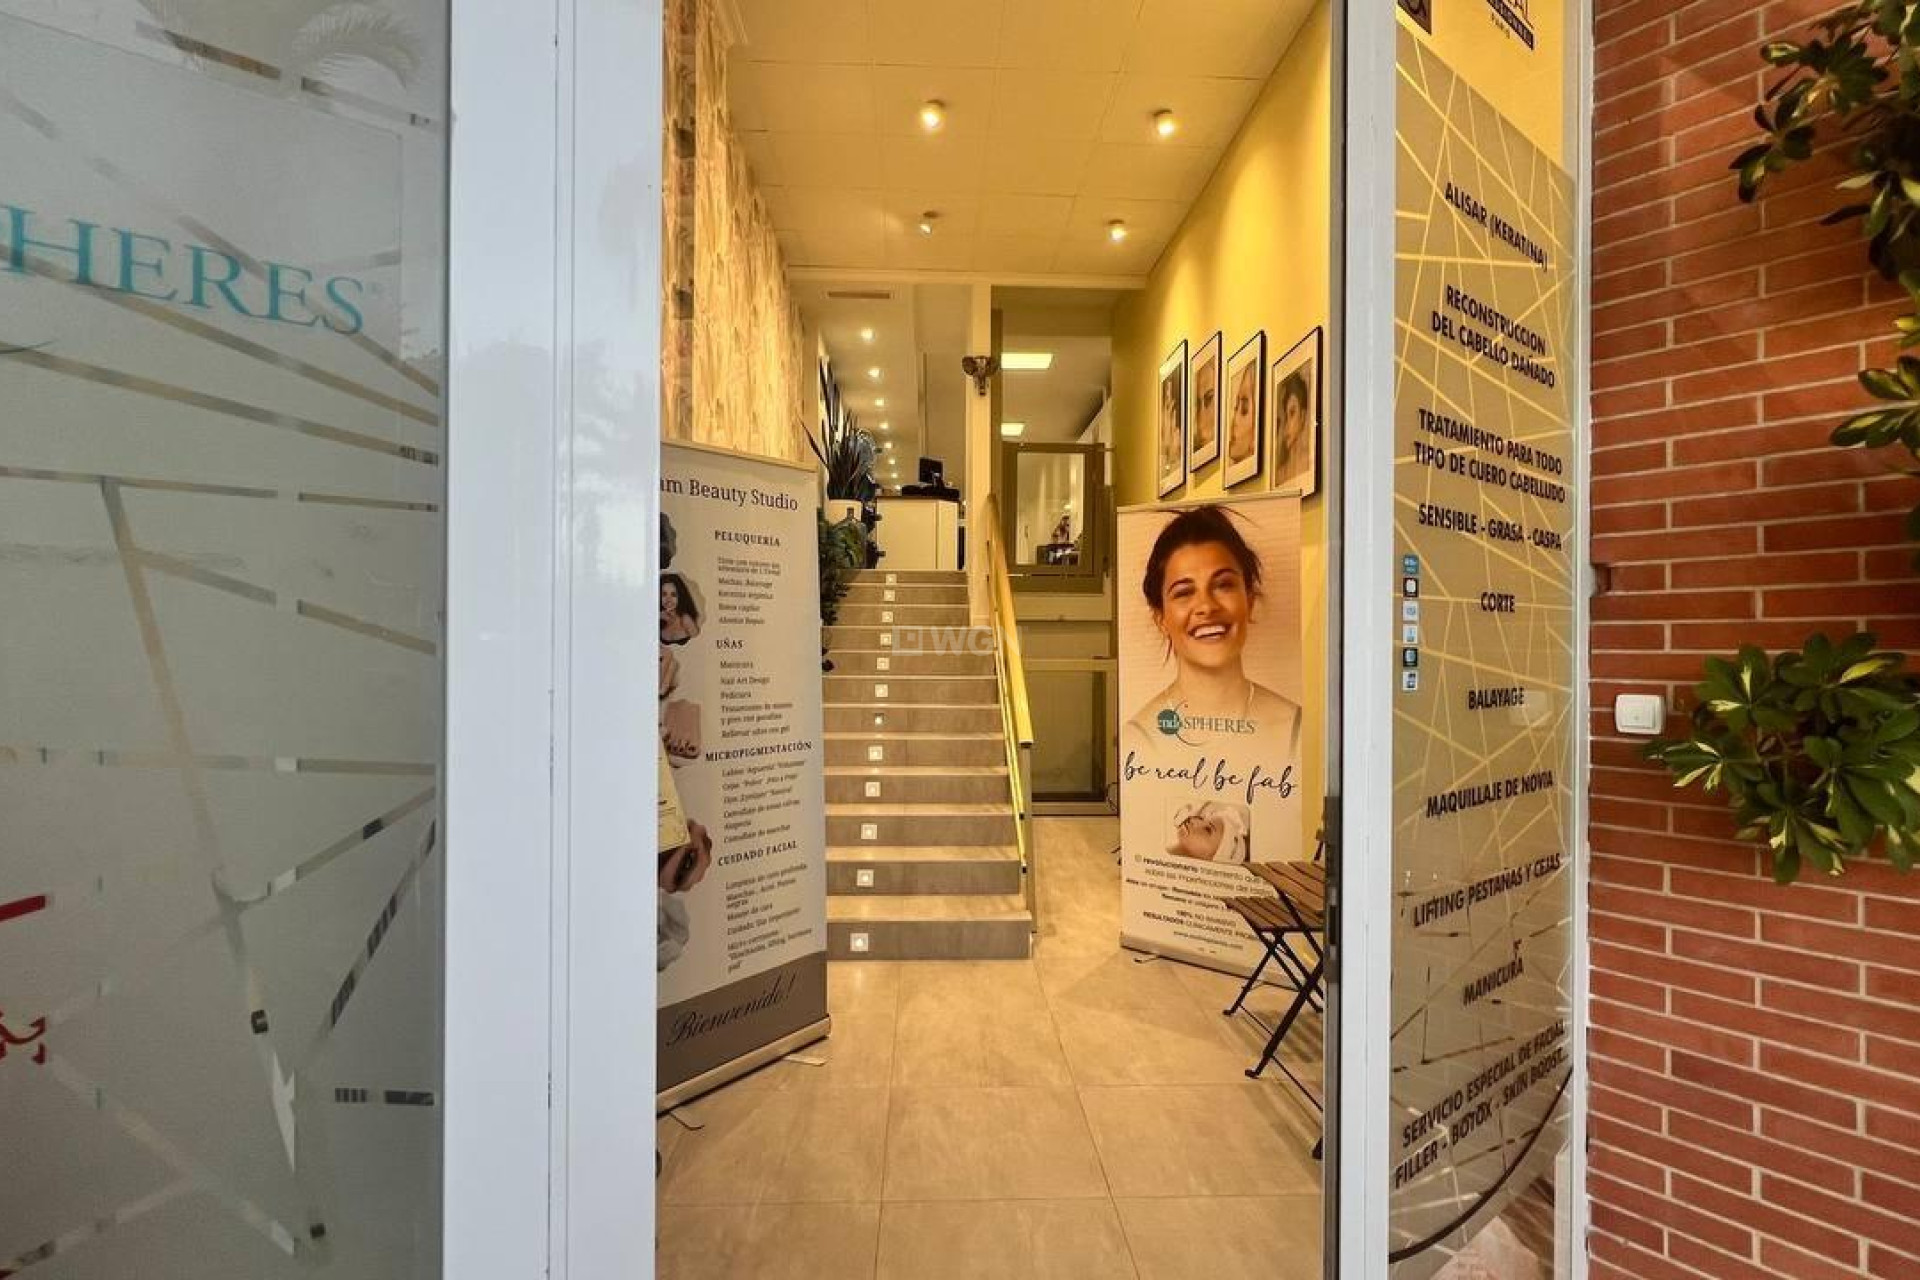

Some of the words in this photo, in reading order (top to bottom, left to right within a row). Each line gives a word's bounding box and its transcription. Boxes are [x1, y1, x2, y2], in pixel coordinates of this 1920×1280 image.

[1446, 182, 1487, 227] ALISAR
[1490, 214, 1548, 272] (KERATINA)
[1446, 285, 1546, 355] RECONSTRUCCION
[1432, 311, 1455, 340] DEL
[1460, 324, 1508, 364] CABELLO
[1511, 352, 1555, 388] DAÑADO
[1419, 409, 1502, 455] TRATAMIENTO
[1508, 441, 1533, 465] PARA
[1536, 451, 1562, 475] TODO
[690, 479, 746, 506] Beauty
[751, 488, 798, 511] Studio
[1414, 442, 1444, 469] TIPO
[1450, 453, 1465, 475] DE
[1469, 459, 1506, 486] CUERO
[1510, 472, 1565, 502] CABELLUDO
[1418, 504, 1476, 534] SENSIBLE
[1488, 519, 1524, 542] GRASA
[1533, 528, 1562, 550] CASPA
[1480, 592, 1515, 613] CORTE
[716, 637, 744, 650] UÑAS
[1468, 688, 1524, 710] BALAYAGE
[1184, 716, 1256, 734] SPHERES
[706, 741, 812, 761] MICROPIGMENTACIÓN
[1124, 752, 1149, 781] be
[1155, 757, 1208, 790] real
[1213, 759, 1243, 792] be
[1246, 765, 1297, 804] fab
[1426, 783, 1502, 818] MAQUILLAJE
[1506, 778, 1519, 797] DE
[1522, 770, 1553, 794] NOVIA
[718, 848, 764, 866] CUIDADO
[766, 840, 798, 856] FACIAL
[1414, 889, 1464, 928] LIFTING
[1468, 866, 1523, 906] PESTAÑAS
[1525, 864, 1532, 882] Y
[1534, 853, 1561, 878] CEJAS
[1463, 956, 1524, 1006] MANICURA
[1403, 1089, 1463, 1148] SERVICIO
[1467, 1052, 1516, 1101] ESPECIAL
[1518, 1041, 1532, 1065] DE
[1396, 1139, 1438, 1189] FILLER
[1452, 1098, 1492, 1146] BOTOX
[1503, 1071, 1528, 1106] SKIN
